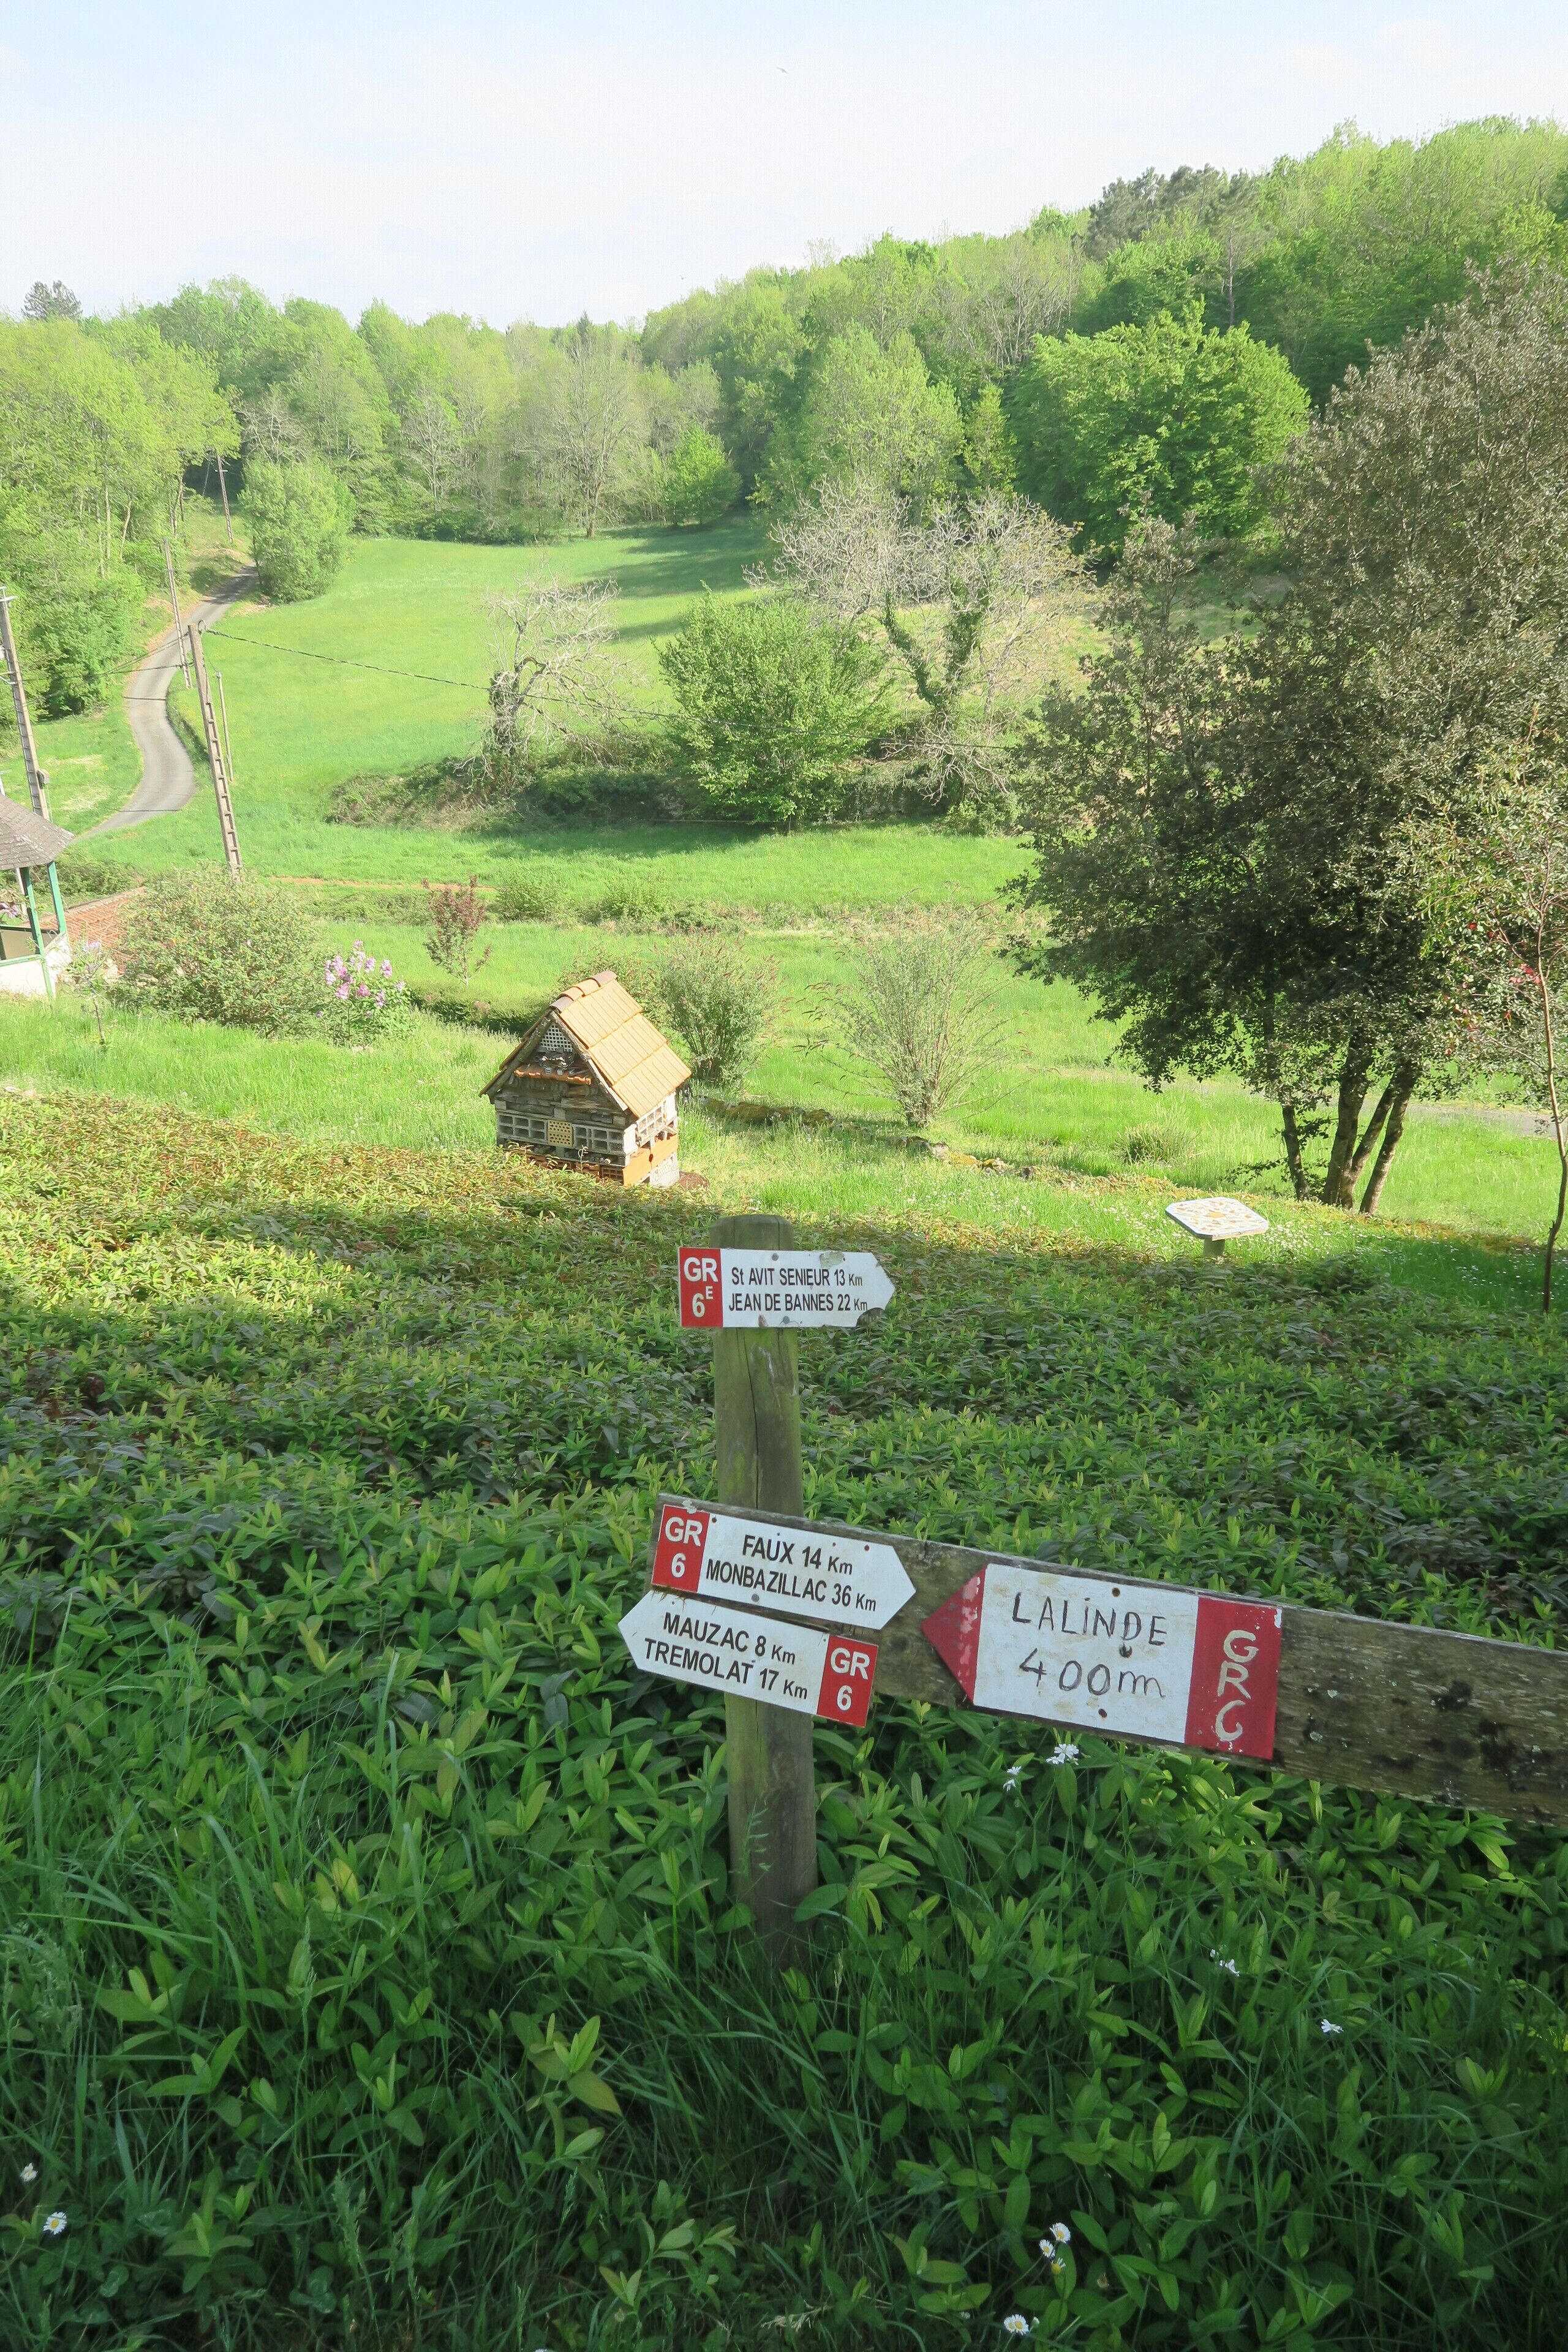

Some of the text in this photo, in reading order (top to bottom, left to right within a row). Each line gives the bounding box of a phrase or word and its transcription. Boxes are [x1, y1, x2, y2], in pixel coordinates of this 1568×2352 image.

[684, 1257, 718, 1283] GR
[731, 1267, 863, 1286] St AVIT SENIEUR 13 Km
[729, 1294, 868, 1311] JEAN DE BANNES 22 Km
[664, 1516, 703, 1547] GR
[671, 1553, 686, 1578] 6
[742, 1534, 853, 1575] FAUX 14 Km
[706, 1559, 876, 1611] MONBAZILLAC 36 Km
[663, 1612, 796, 1665] MAUZAC 8 Km
[644, 1638, 808, 1700] TREMOLAT 17 Km
[829, 1648, 870, 1680] GR
[1018, 1647, 1166, 1699] 400m
[837, 1686, 852, 1711] 6
